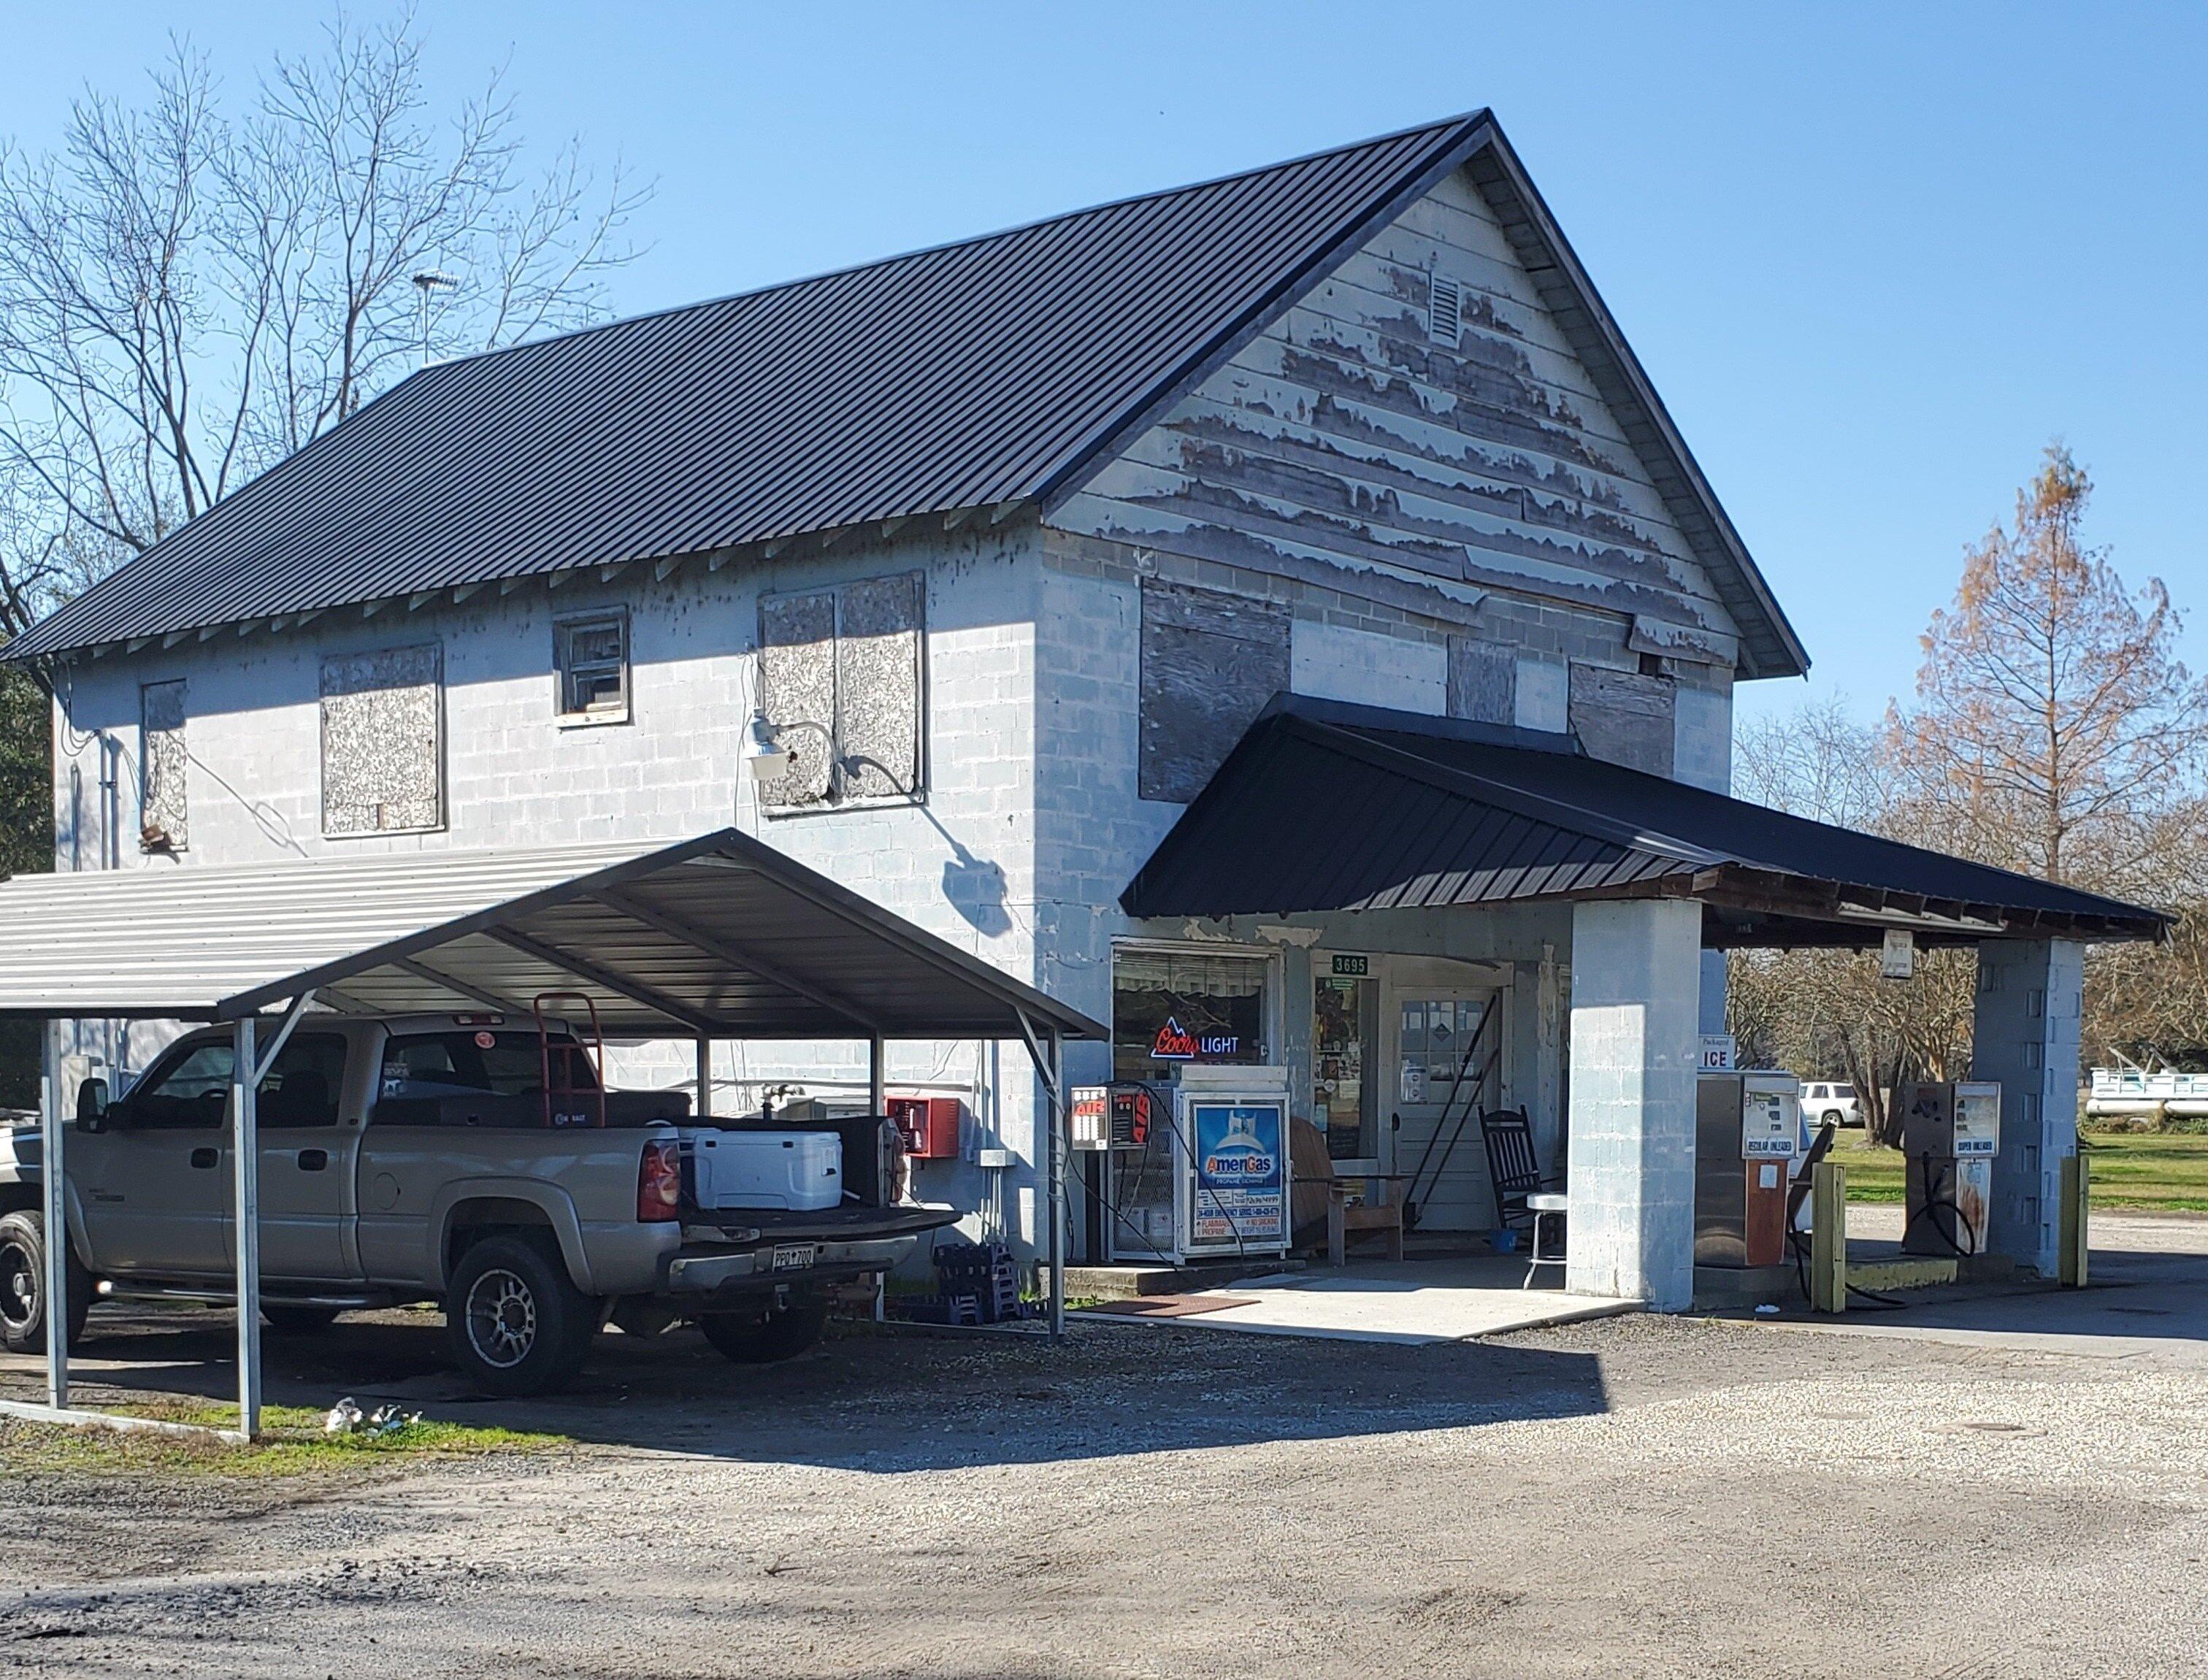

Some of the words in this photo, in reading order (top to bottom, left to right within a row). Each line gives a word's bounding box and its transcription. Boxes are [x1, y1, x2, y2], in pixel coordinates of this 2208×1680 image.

[1335, 957, 1365, 973] 3695
[1156, 1025, 1200, 1053] Coors
[1201, 1036, 1239, 1053] LIGHT
[1703, 1051, 1728, 1067] ICE
[1075, 1099, 1105, 1116] AIR
[1132, 1092, 1149, 1143] AIR
[1206, 1155, 1270, 1173] AmeriGas
